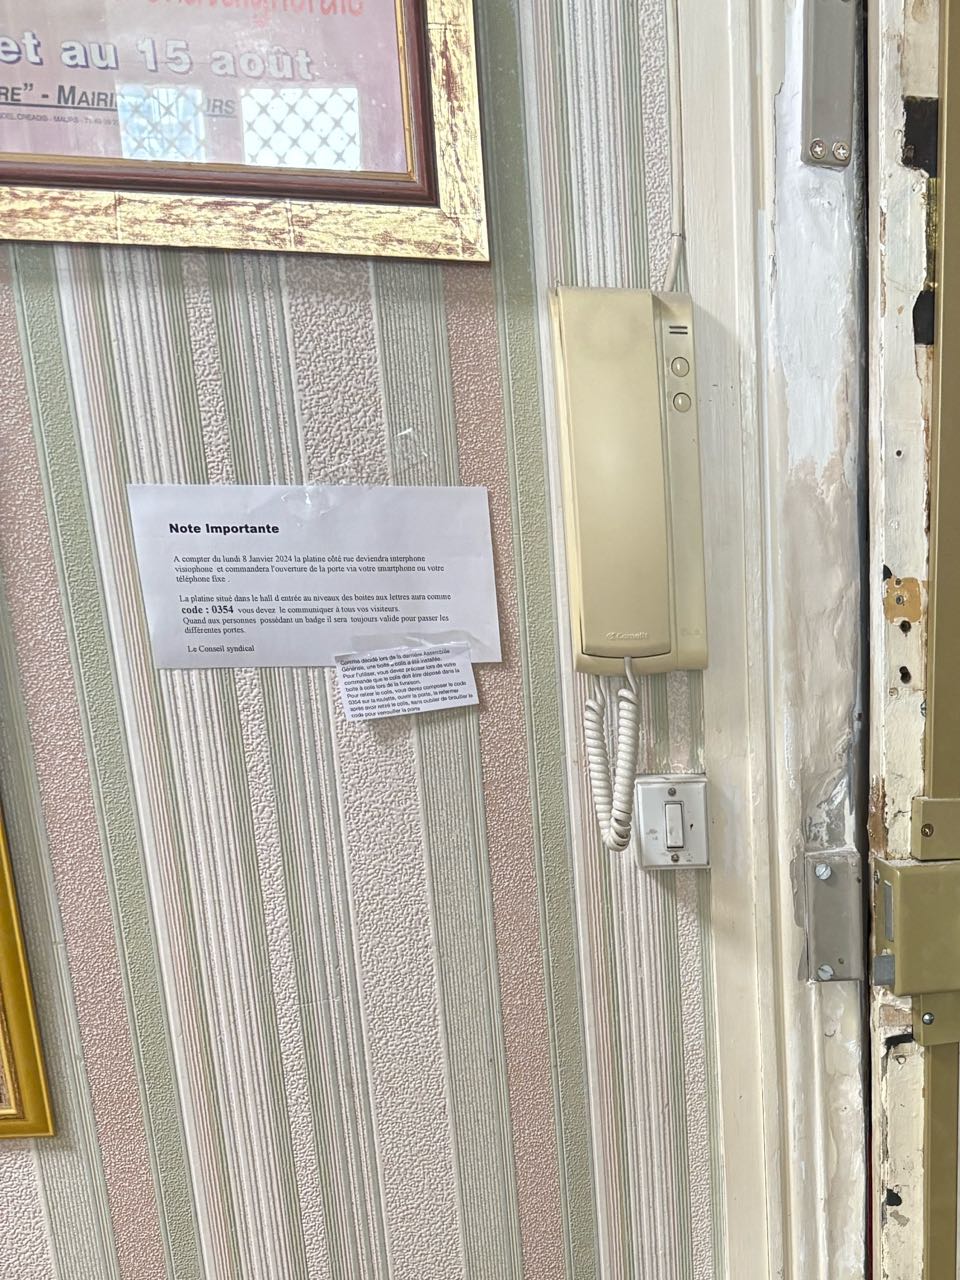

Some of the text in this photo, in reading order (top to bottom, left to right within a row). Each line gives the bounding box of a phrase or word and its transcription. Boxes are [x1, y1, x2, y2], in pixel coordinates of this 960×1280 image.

[60, 39, 118, 70] au
[136, 37, 193, 74] 15
[210, 46, 315, 81] août
[56, 84, 118, 108] MAIRI
[204, 98, 236, 115] IRS
[169, 523, 280, 536] Note Importante
[182, 556, 210, 564] compter
[302, 555, 326, 564] platine
[390, 555, 426, 564] interphone
[174, 565, 214, 574] visiophone
[377, 565, 416, 574] smartphone
[176, 575, 210, 584] téléphone
[190, 594, 214, 603] platine
[181, 606, 203, 614] code
[212, 606, 234, 614] 0354
[288, 606, 334, 614] communiquer
[182, 617, 206, 625] Quand
[260, 616, 293, 625] possédant
[304, 616, 326, 624] badge
[198, 644, 225, 652] Conseil
[226, 644, 255, 653] syndical
